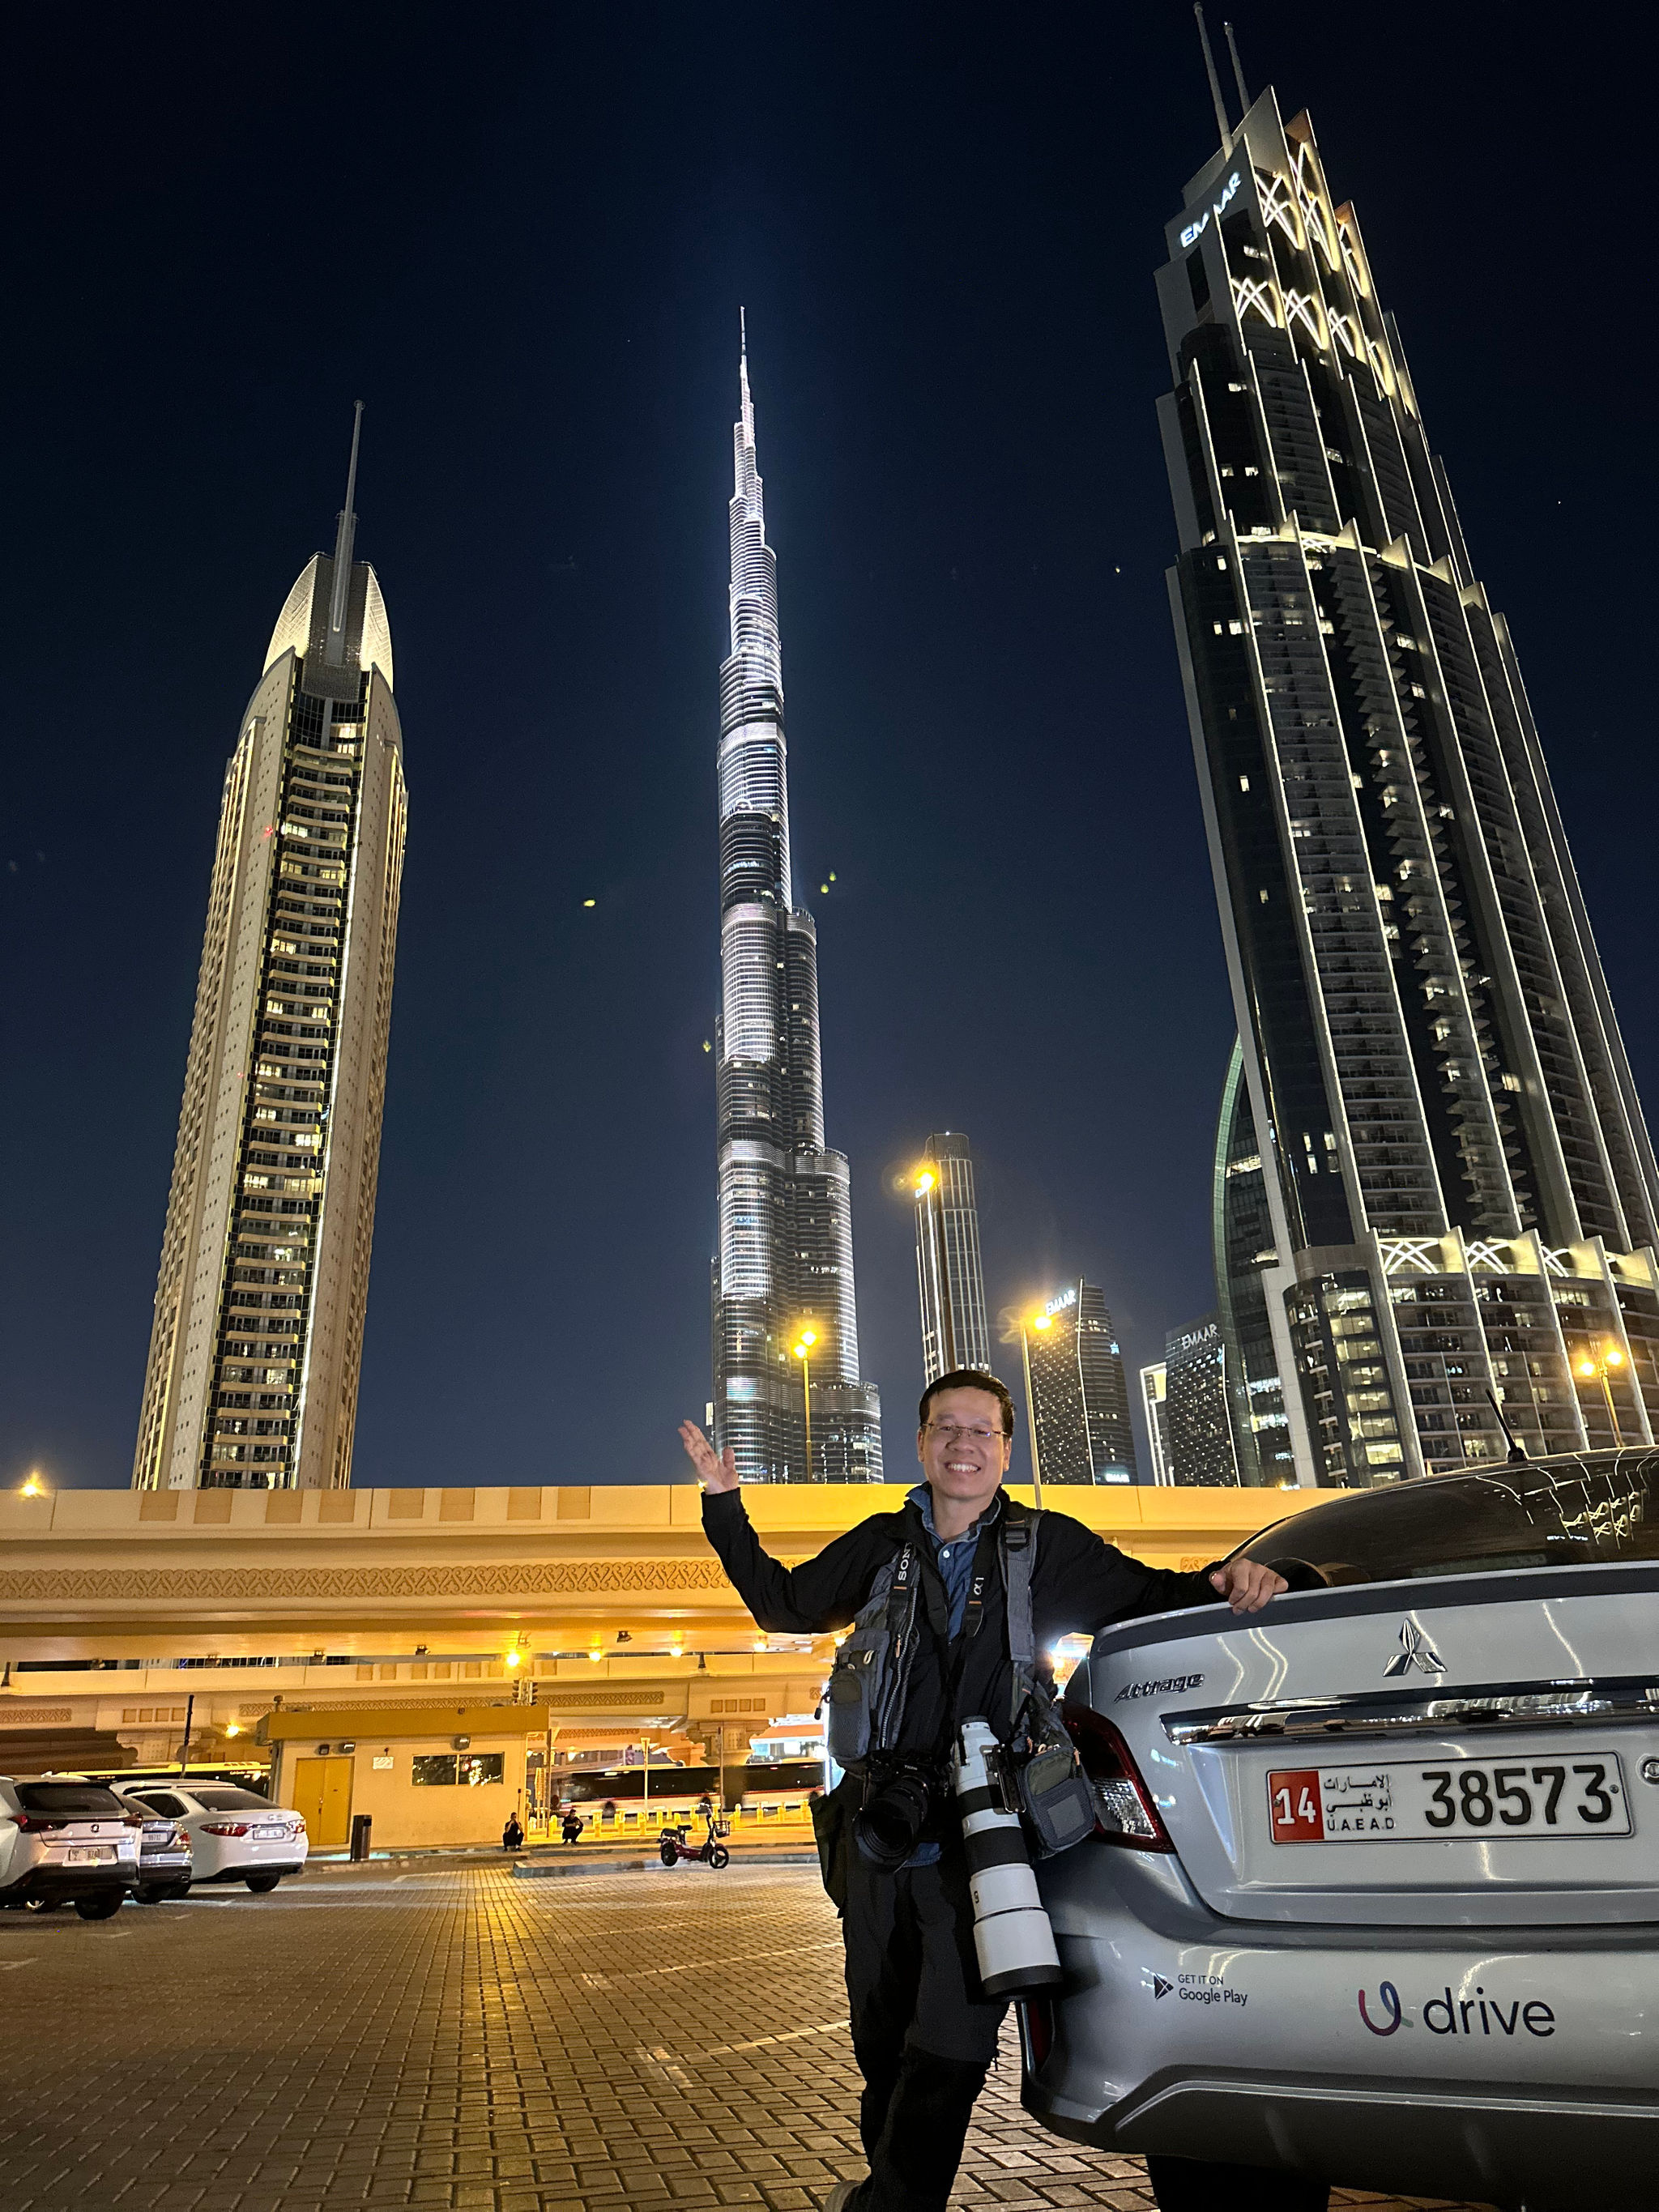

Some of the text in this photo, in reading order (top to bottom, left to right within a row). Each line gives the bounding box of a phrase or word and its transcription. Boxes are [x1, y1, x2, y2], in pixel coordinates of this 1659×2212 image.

[1181, 1323, 1220, 1349] EMAAR
[1114, 1673, 1205, 1704] Attrage
[1275, 1787, 1316, 1826] 14
[1422, 1763, 1612, 1828] 38573
[1178, 1974, 1224, 1986] GET IT ON
[1179, 1987, 1248, 2006] Google Play
